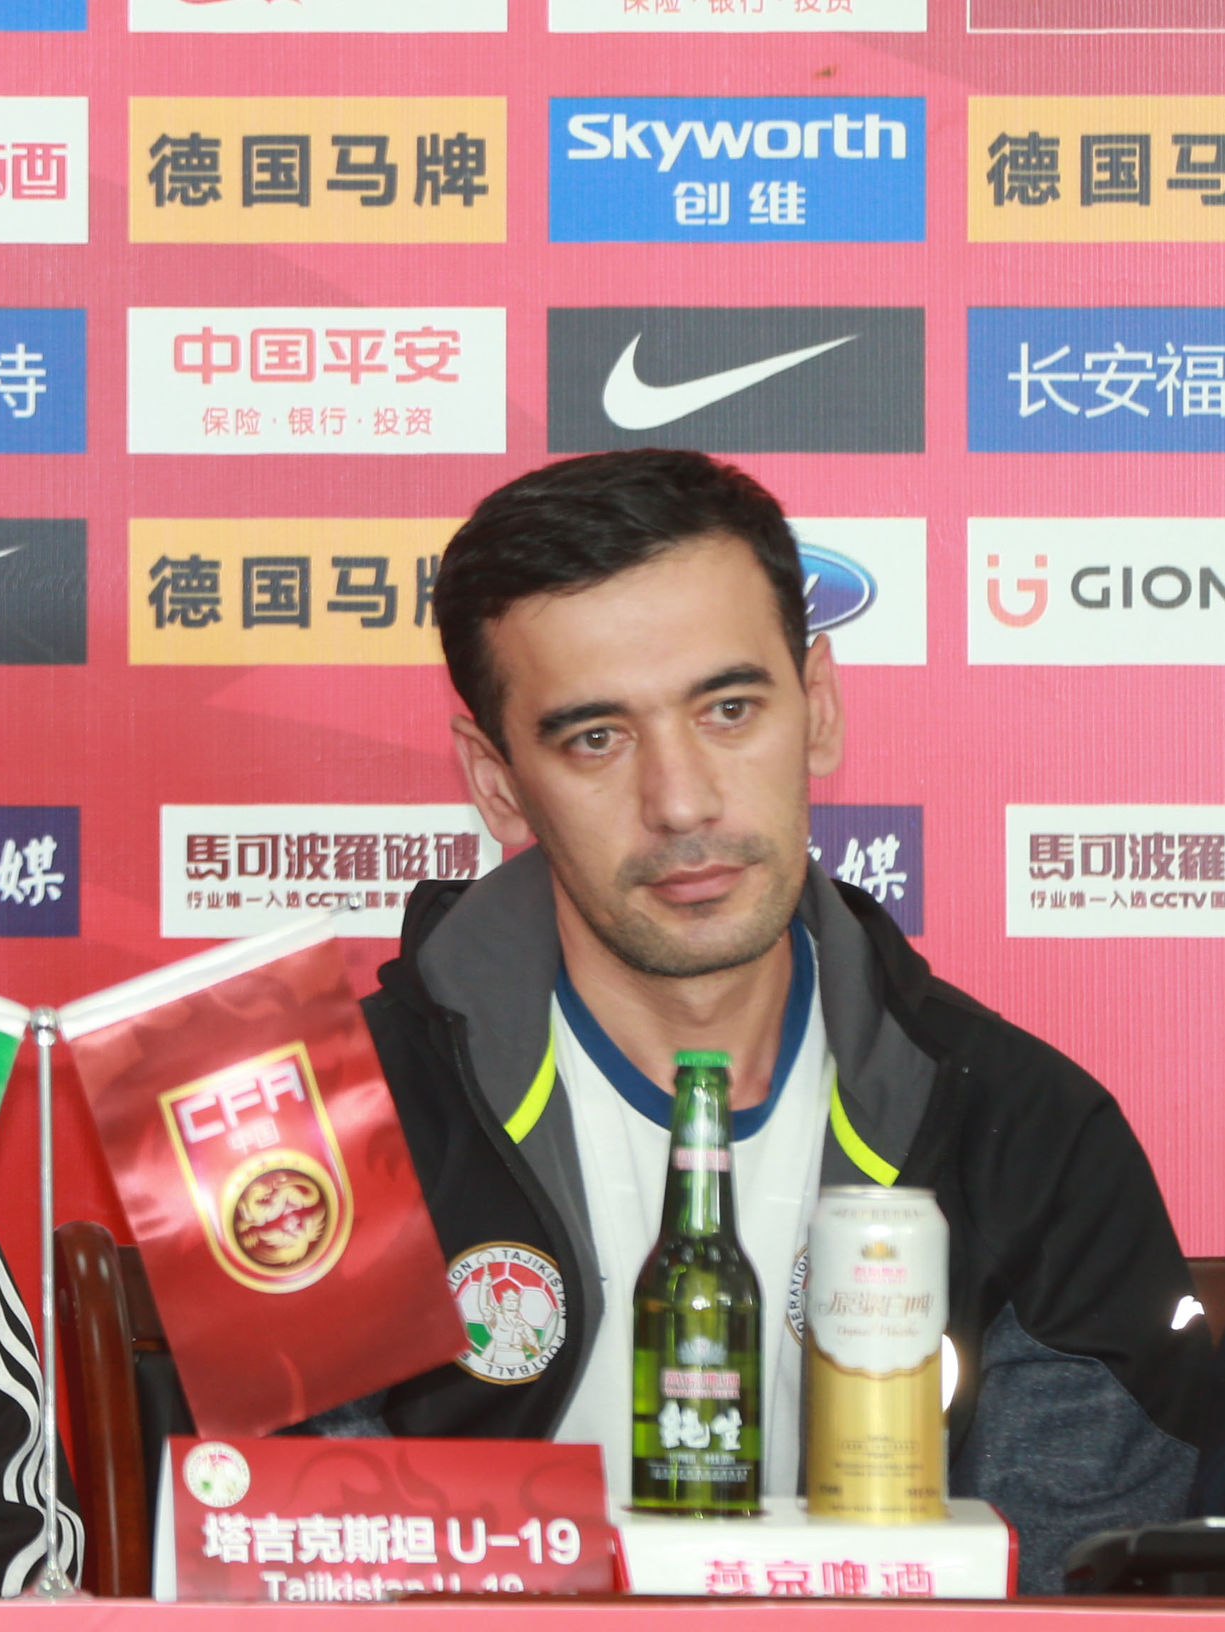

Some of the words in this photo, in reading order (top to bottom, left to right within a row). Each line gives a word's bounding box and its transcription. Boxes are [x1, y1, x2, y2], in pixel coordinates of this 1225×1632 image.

[147, 131, 489, 208] 德国马牌
[567, 113, 906, 173] Skyworth
[986, 131, 1225, 207] 德国马
[673, 181, 806, 226] 创维
[173, 325, 461, 385] 中国平安
[1007, 342, 1225, 419] 长安福
[807, 833, 907, 903] 媒
[177, 1061, 306, 1143] CFA
[202, 1513, 437, 1564] 塔吉克斯坦
[447, 1517, 580, 1564] U-19
[705, 1560, 934, 1597] 燕京啤酒
